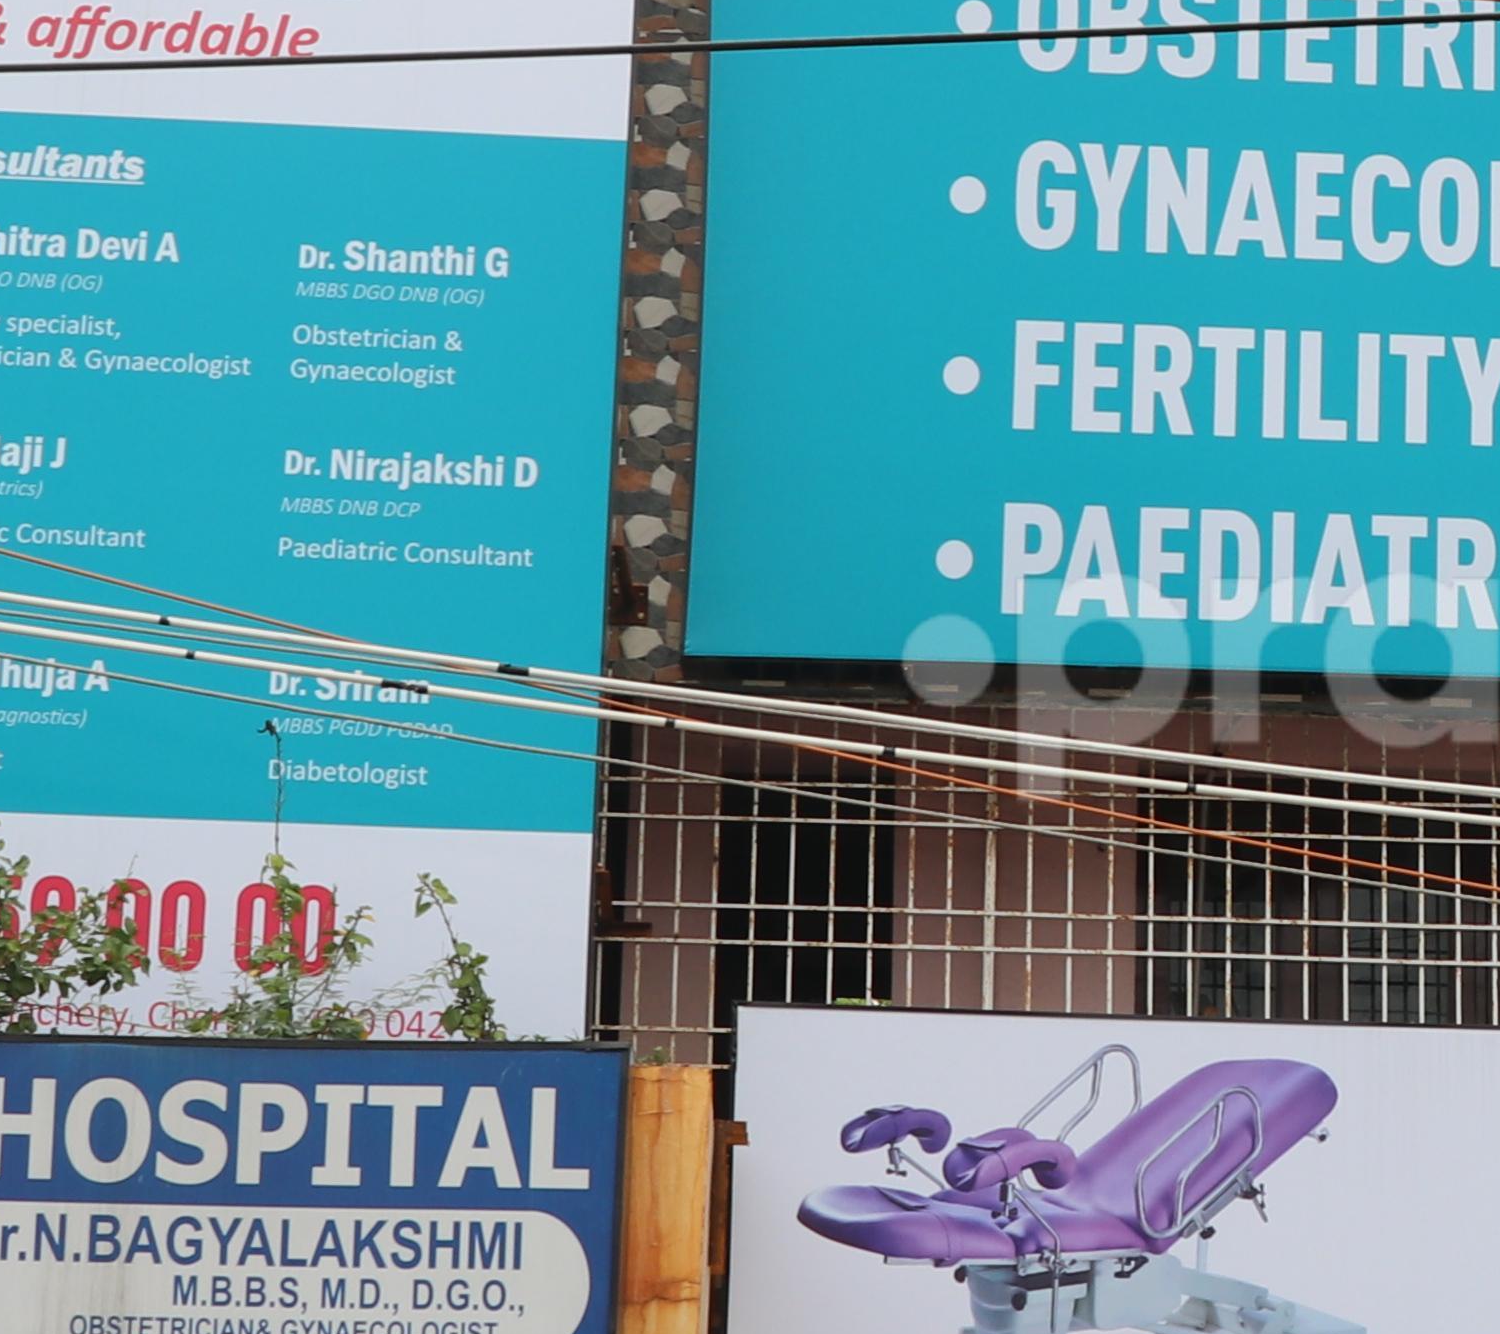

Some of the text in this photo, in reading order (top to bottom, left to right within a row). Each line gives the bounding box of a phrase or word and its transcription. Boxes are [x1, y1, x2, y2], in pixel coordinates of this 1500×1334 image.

[26, 3, 322, 62] affordable
[76, 228, 148, 262] Devi
[154, 232, 180, 263] A
[283, 448, 539, 491] Dr. Nirajakshi D
[278, 537, 533, 567] Paediatric Consultant
[268, 758, 428, 789] Diabetologist
[172, 1275, 309, 1315] M.B.B.S,
